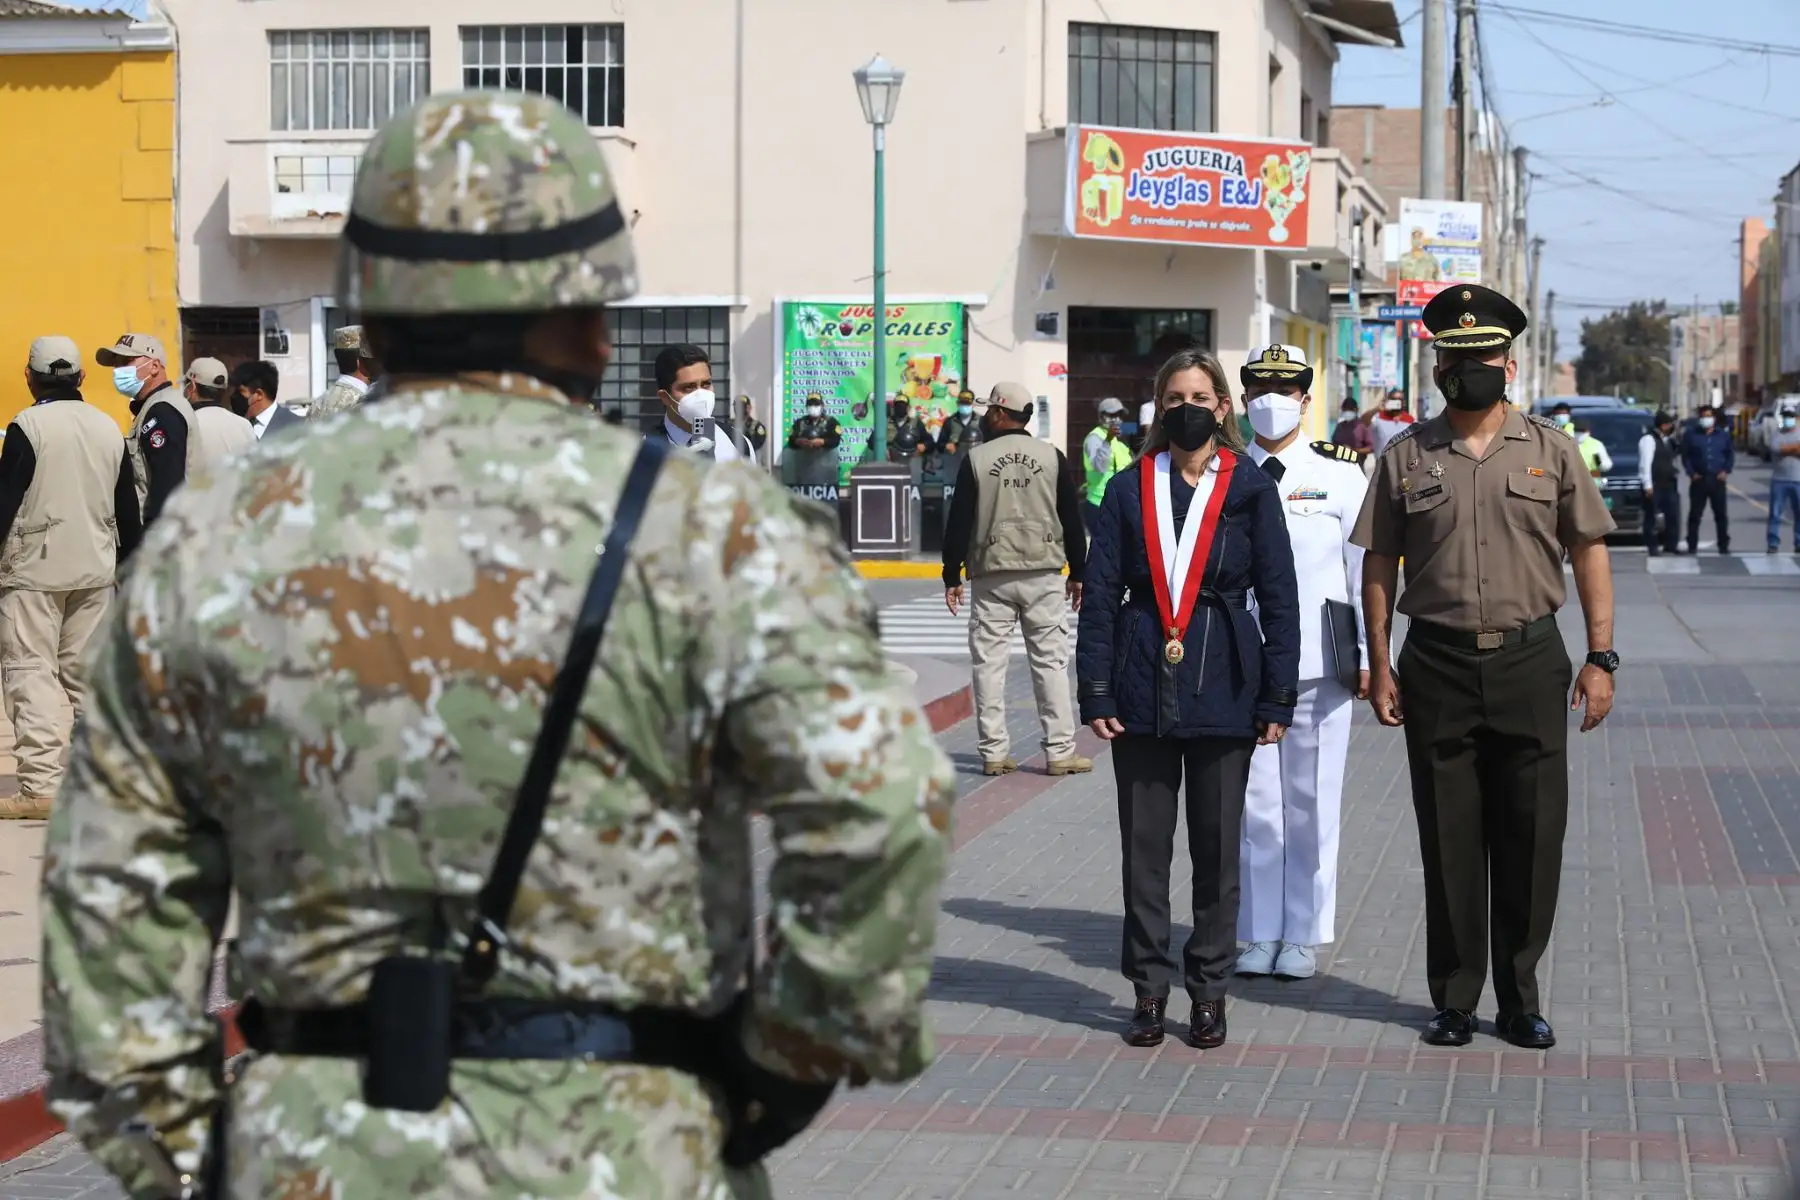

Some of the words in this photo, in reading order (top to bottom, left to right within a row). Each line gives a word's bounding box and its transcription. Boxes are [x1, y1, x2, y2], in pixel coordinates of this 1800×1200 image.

[1144, 149, 1244, 176] JUGUERIA
[1128, 172, 1209, 206] Jeyglas
[1222, 178, 1261, 207] E&J
[989, 452, 1044, 478] DIRSEEST
[788, 482, 838, 500] OLICÍA
